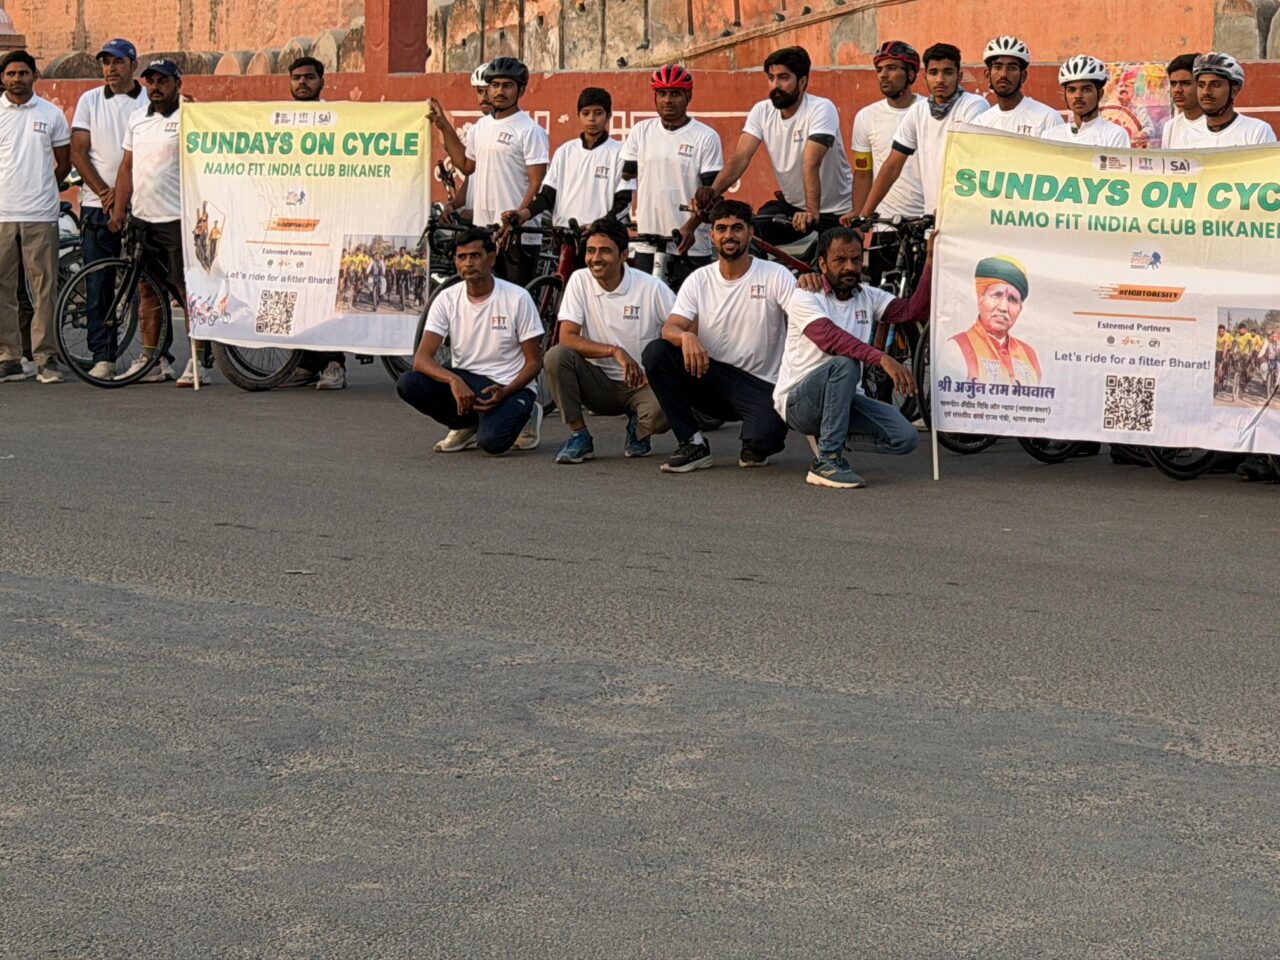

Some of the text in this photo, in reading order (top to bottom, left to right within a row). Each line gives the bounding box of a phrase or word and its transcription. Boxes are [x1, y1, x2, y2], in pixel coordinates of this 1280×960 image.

[1018, 125, 1032, 135] FIT
[186, 131, 419, 156] SUNDAYS ON CYCLE
[203, 162, 391, 178] NAMO FIT INDIA CLUB BIKANER
[954, 168, 1130, 206] SUNDAYS
[1141, 181, 1197, 208] ON
[990, 209, 1049, 228] NAMO
[1055, 213, 1082, 230] FIT
[1088, 215, 1141, 233] INDIA
[1147, 218, 1196, 235] CLUB
[248, 272, 266, 281] ride
[267, 273, 280, 282] for
[751, 285, 765, 295] FIT
[623, 305, 640, 315] FIT
[492, 315, 507, 325] FIT
[1097, 321, 1171, 332] Esteemed Partners
[1054, 351, 1211, 370] Let's ride for a fitter Bharat!
[938, 376, 1056, 399] श्री अर्जुन राम मेघवाल
